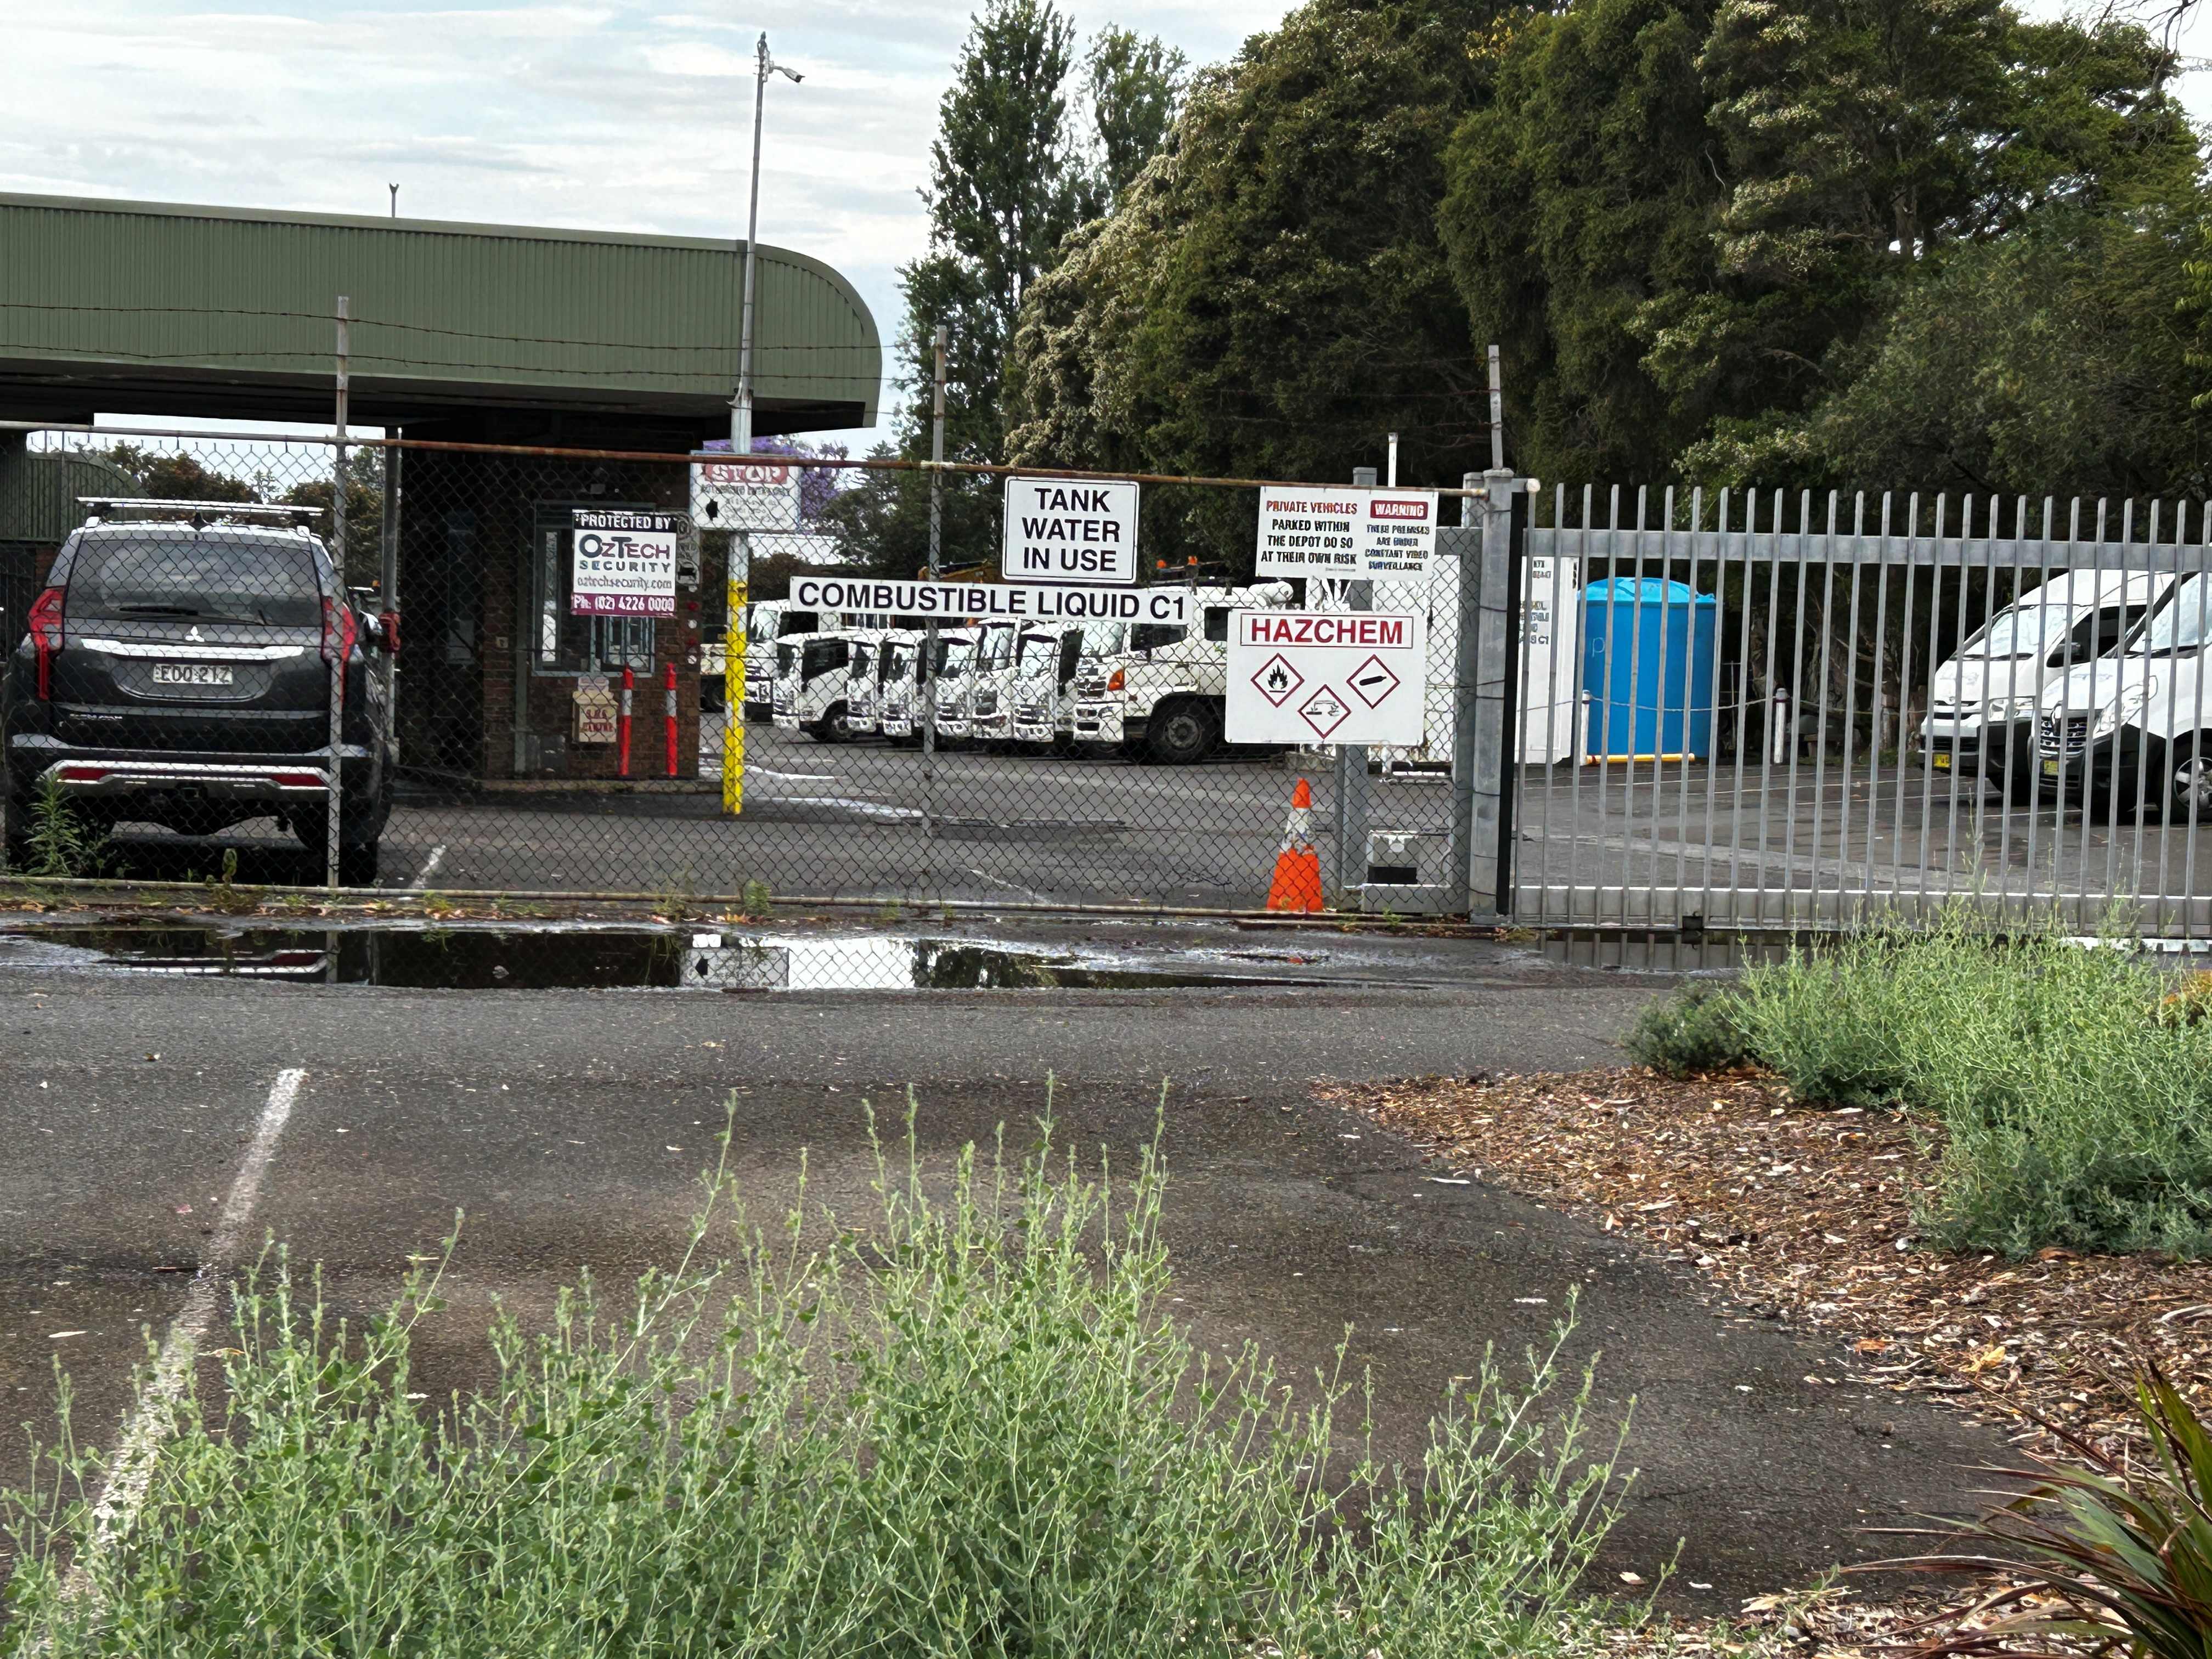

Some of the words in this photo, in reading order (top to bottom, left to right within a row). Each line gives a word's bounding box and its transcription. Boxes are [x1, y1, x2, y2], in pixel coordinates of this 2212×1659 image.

[1034, 488, 1110, 512] TANK
[1266, 500, 1307, 513] PRIVATE
[1310, 502, 1357, 515] VEHICLES
[1375, 504, 1424, 517] WARNING
[581, 514, 652, 529] PROTECTED
[655, 516, 671, 529] BY
[1272, 519, 1311, 531] PARKED
[1314, 521, 1350, 532] WITHIN
[1022, 517, 1120, 543] WATER
[1267, 535, 1286, 546] THE
[1289, 535, 1321, 548] DEPOT
[1324, 537, 1338, 548] DO
[1340, 537, 1353, 549] SO
[1024, 547, 1050, 569] IN
[1060, 549, 1116, 572] USE
[1261, 550, 1274, 562] AT
[1276, 551, 1305, 563] THEIR
[1308, 552, 1331, 564] OWN
[1334, 553, 1357, 565] RISK
[579, 560, 671, 573] SECURITY
[618, 596, 645, 611] 4226
[798, 582, 1028, 614] COMBUSTIBLE
[1038, 591, 1139, 618] LIQUID
[1150, 595, 1183, 619] C1
[1251, 618, 1403, 644] HAZCHEM
